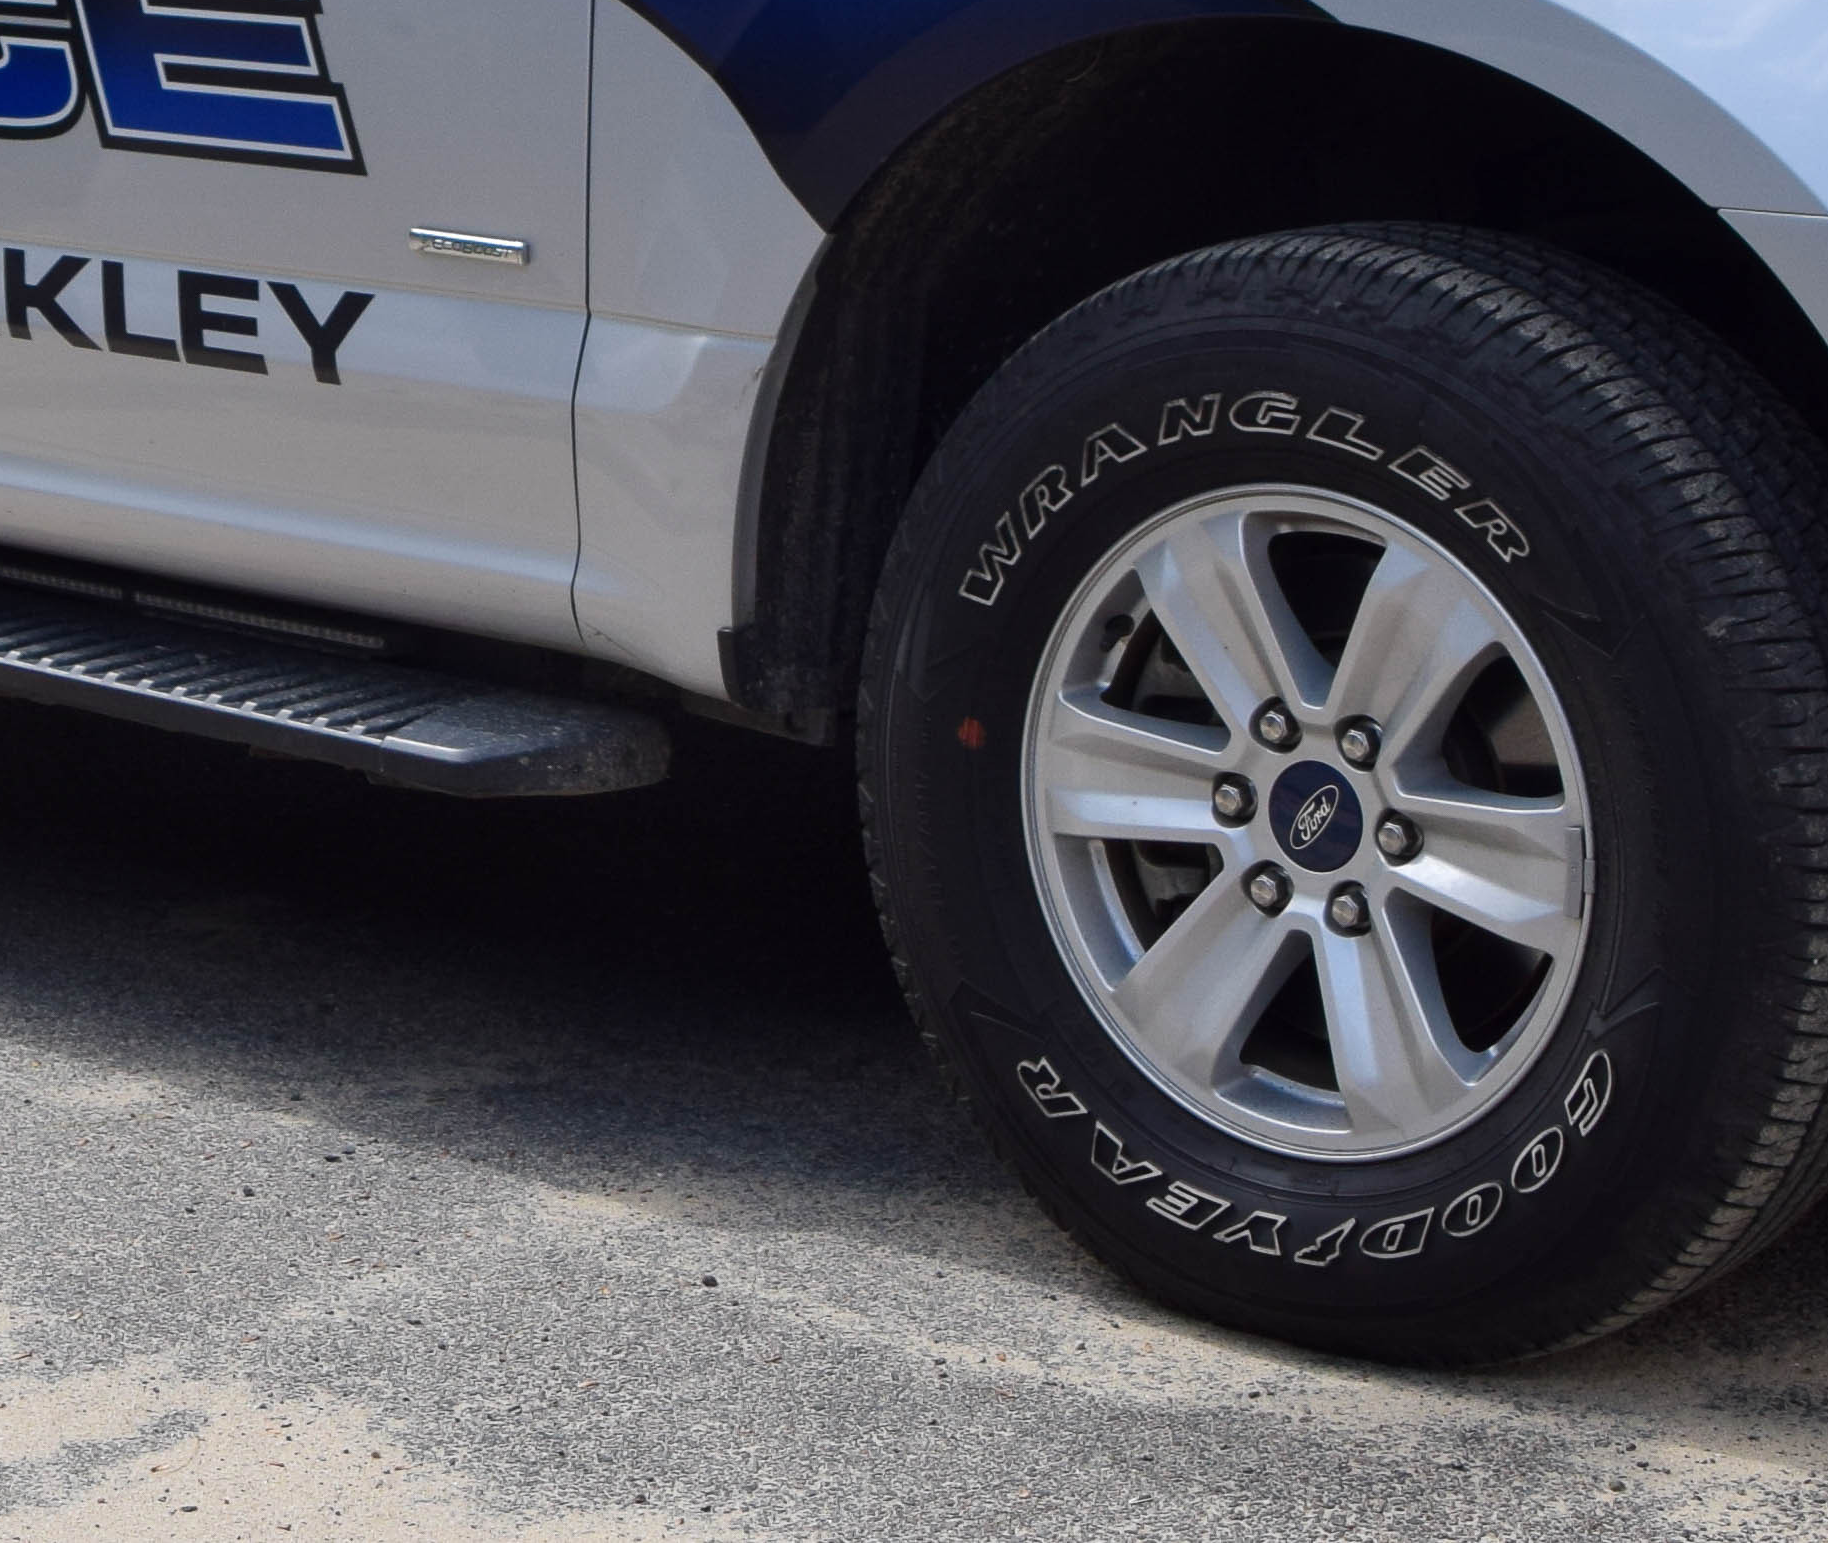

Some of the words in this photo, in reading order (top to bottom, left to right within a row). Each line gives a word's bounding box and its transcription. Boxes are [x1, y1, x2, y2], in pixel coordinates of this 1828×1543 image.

[958, 390, 1532, 607] WRANGLER
[1297, 796, 1332, 841] Ford
[1016, 1049, 1613, 1266] GOODYEAR
